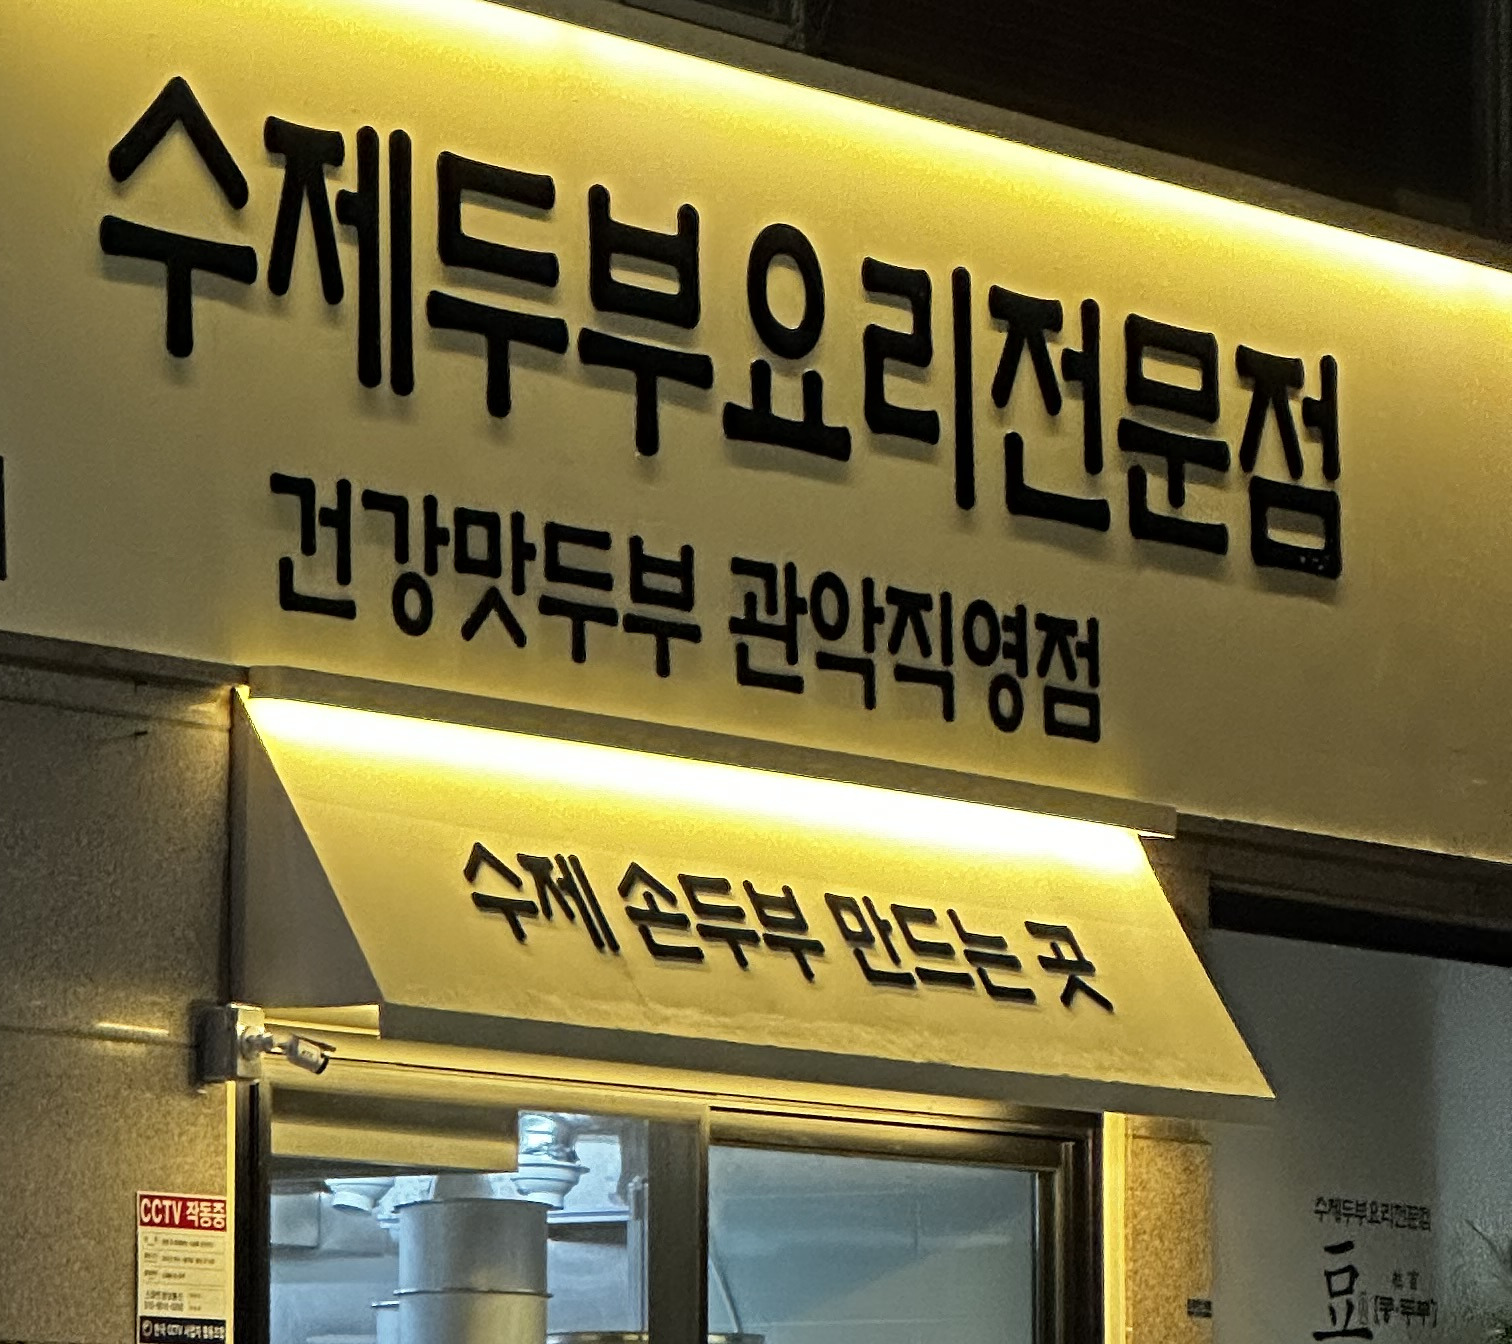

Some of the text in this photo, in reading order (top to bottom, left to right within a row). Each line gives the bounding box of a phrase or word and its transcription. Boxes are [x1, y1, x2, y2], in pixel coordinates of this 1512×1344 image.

[99, 75, 1343, 581] 수제두부요리전문점
[269, 472, 1102, 744] 건강맛두부 관악직영점
[462, 841, 621, 953] 수제
[617, 860, 826, 982] 손두부
[140, 1198, 226, 1229] CCTV 작동중
[1313, 1240, 1373, 1341] 豆
